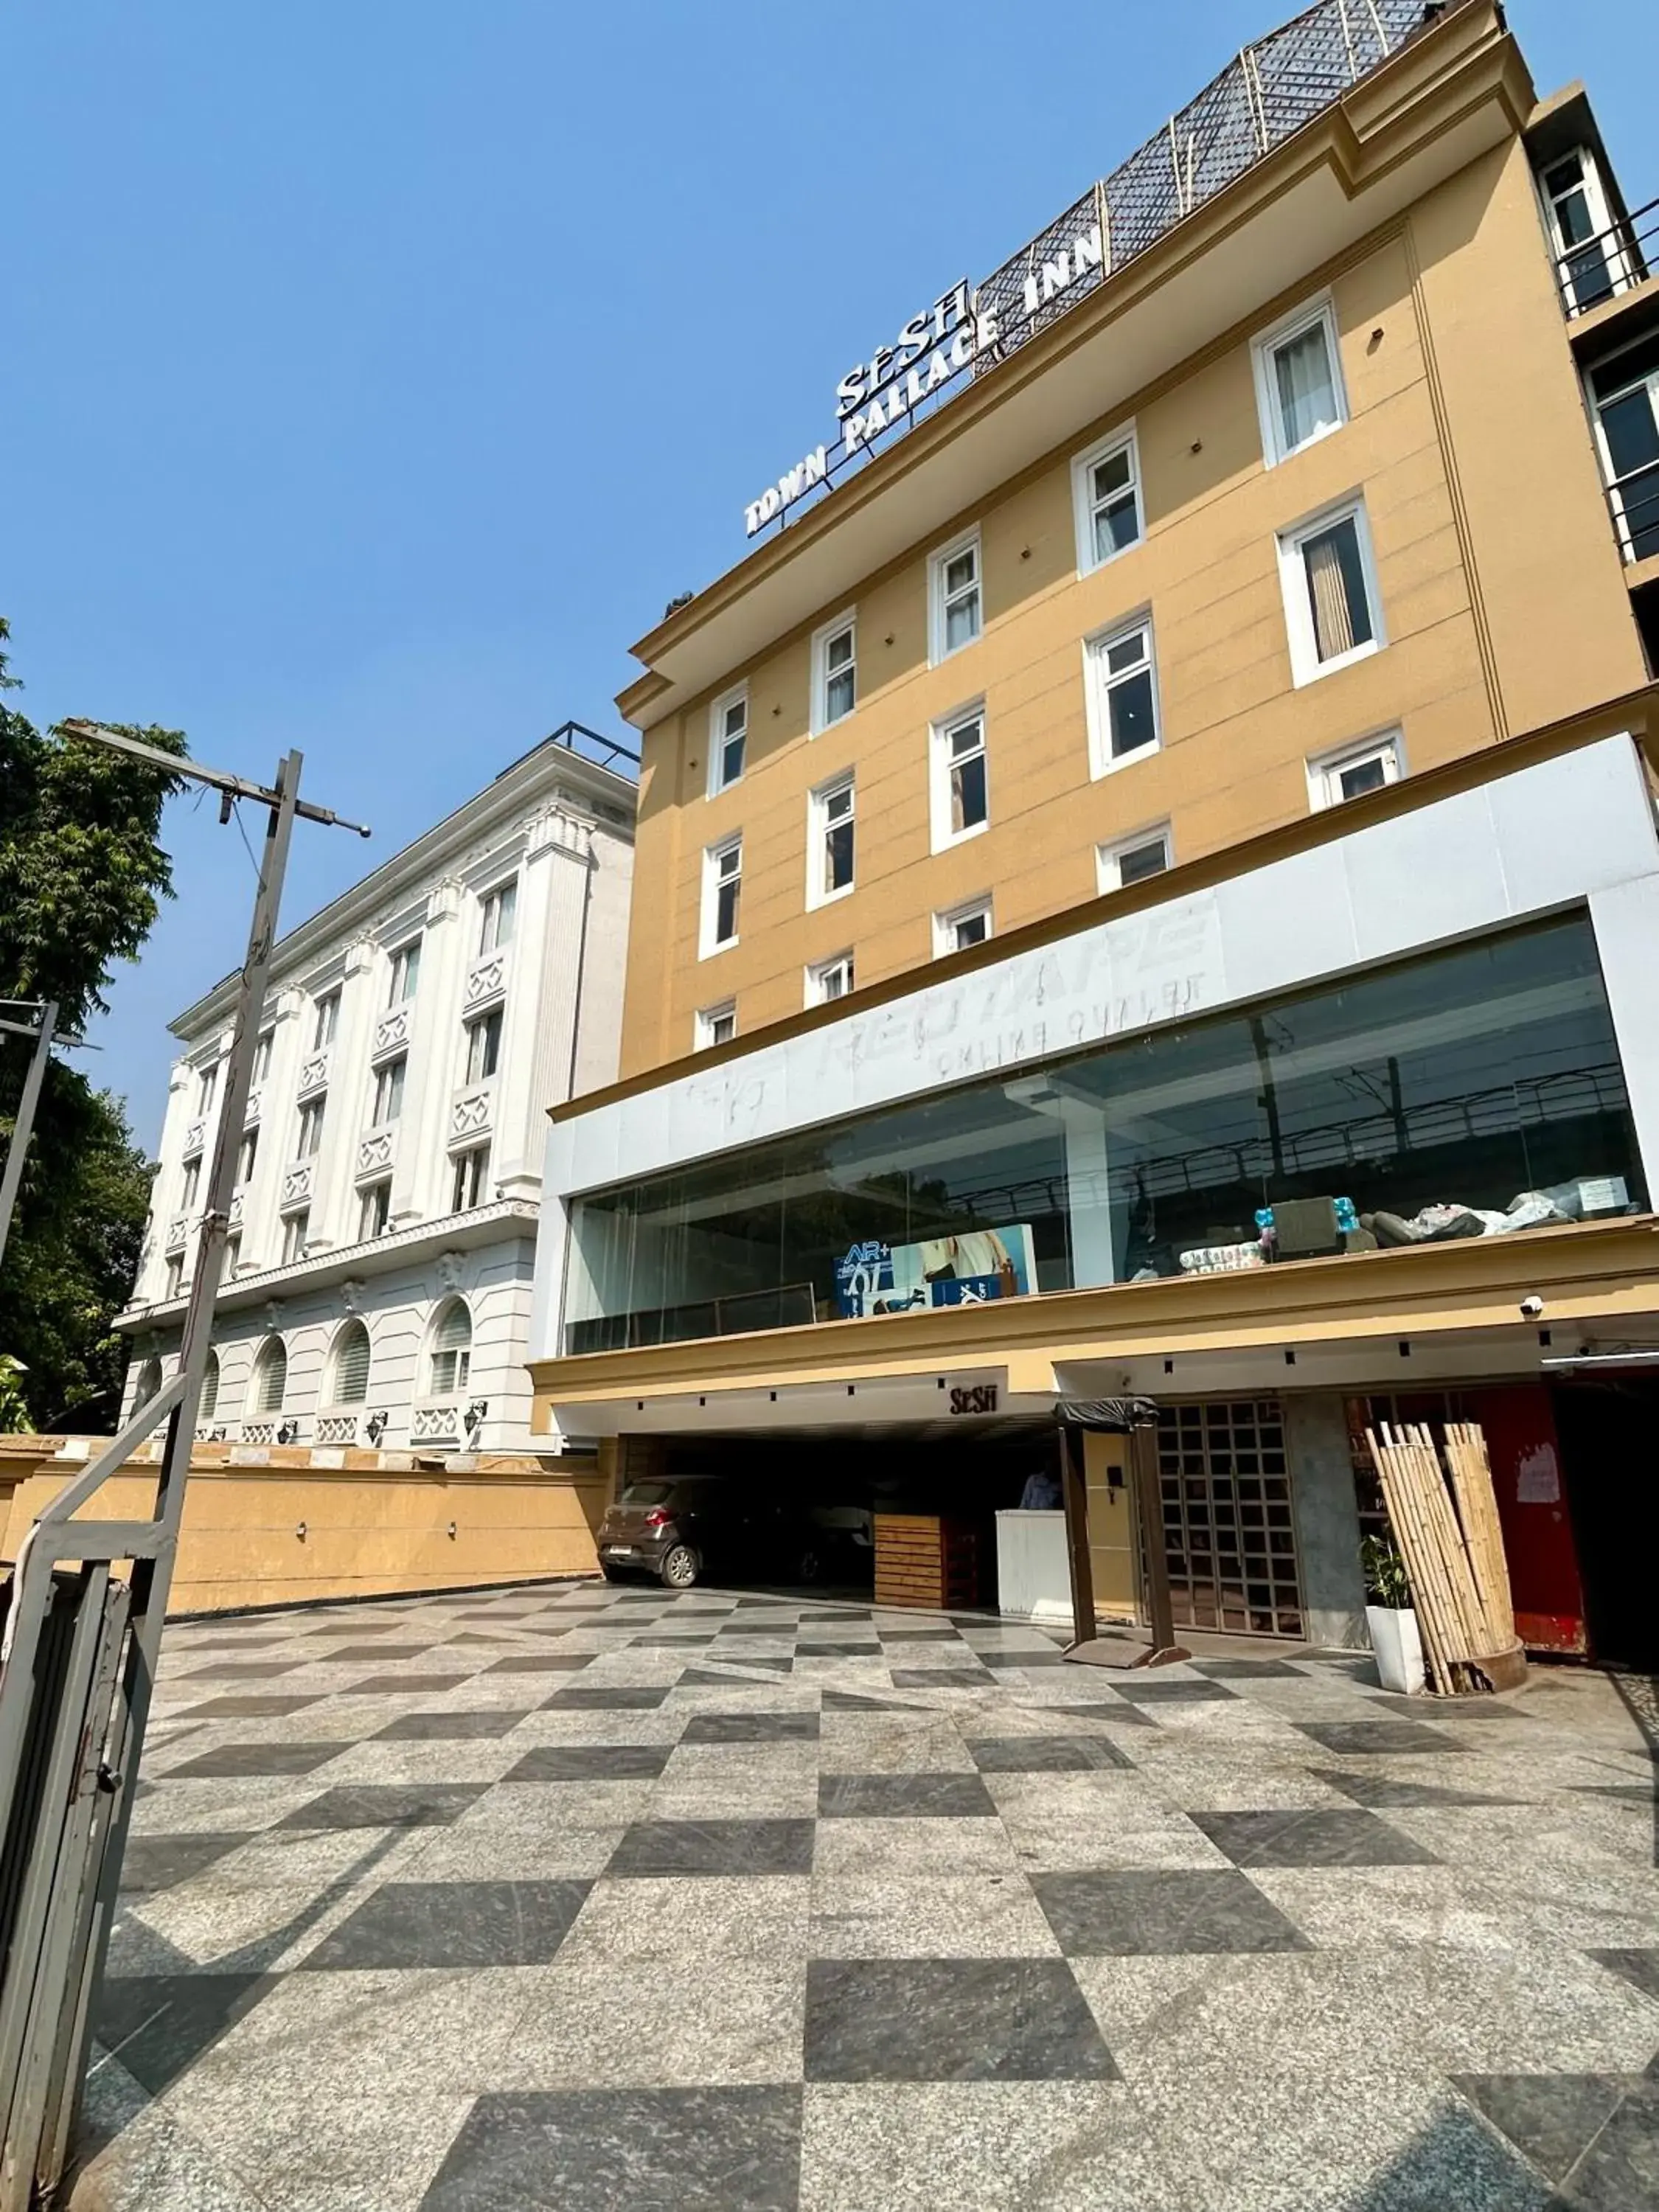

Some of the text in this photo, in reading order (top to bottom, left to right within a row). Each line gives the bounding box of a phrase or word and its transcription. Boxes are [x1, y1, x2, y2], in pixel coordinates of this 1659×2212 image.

[745, 223, 1102, 533] TOWN PALLACE INN
